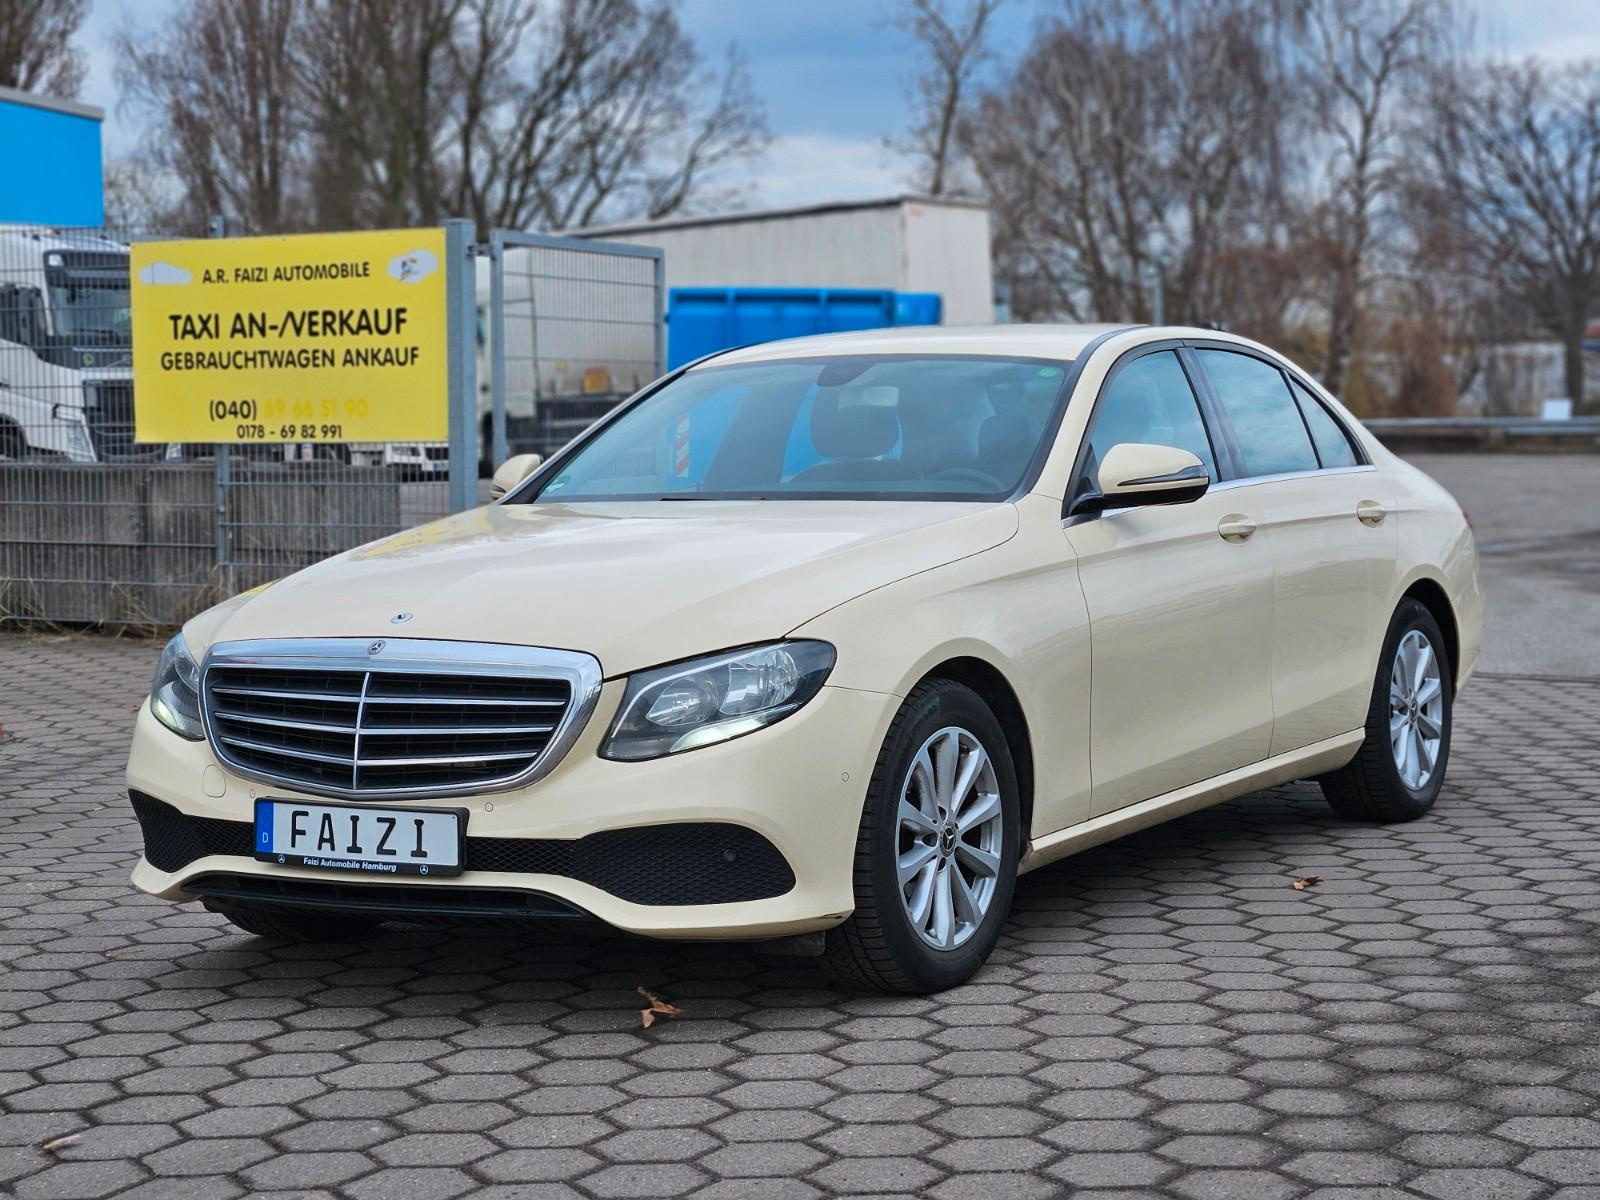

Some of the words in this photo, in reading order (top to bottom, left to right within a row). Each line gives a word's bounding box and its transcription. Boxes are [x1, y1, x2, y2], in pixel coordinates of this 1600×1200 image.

[203, 269, 229, 283] A.R.
[234, 266, 268, 283] FAIZI
[273, 262, 370, 281] AUTOMOBILE
[169, 313, 220, 340] TAXI
[161, 349, 335, 370] GEBRAUCHTWAGEN
[342, 347, 419, 367] ANKAUF
[209, 399, 257, 421] (040)
[236, 424, 265, 439] 0178
[280, 424, 296, 439] 69
[300, 424, 317, 438] 82
[321, 424, 342, 438] 991
[262, 832, 269, 844] D
[290, 810, 428, 858] FAIZI
[303, 857, 320, 866] Faizi
[320, 859, 360, 869] Automobile
[362, 861, 397, 873] Hamburg
